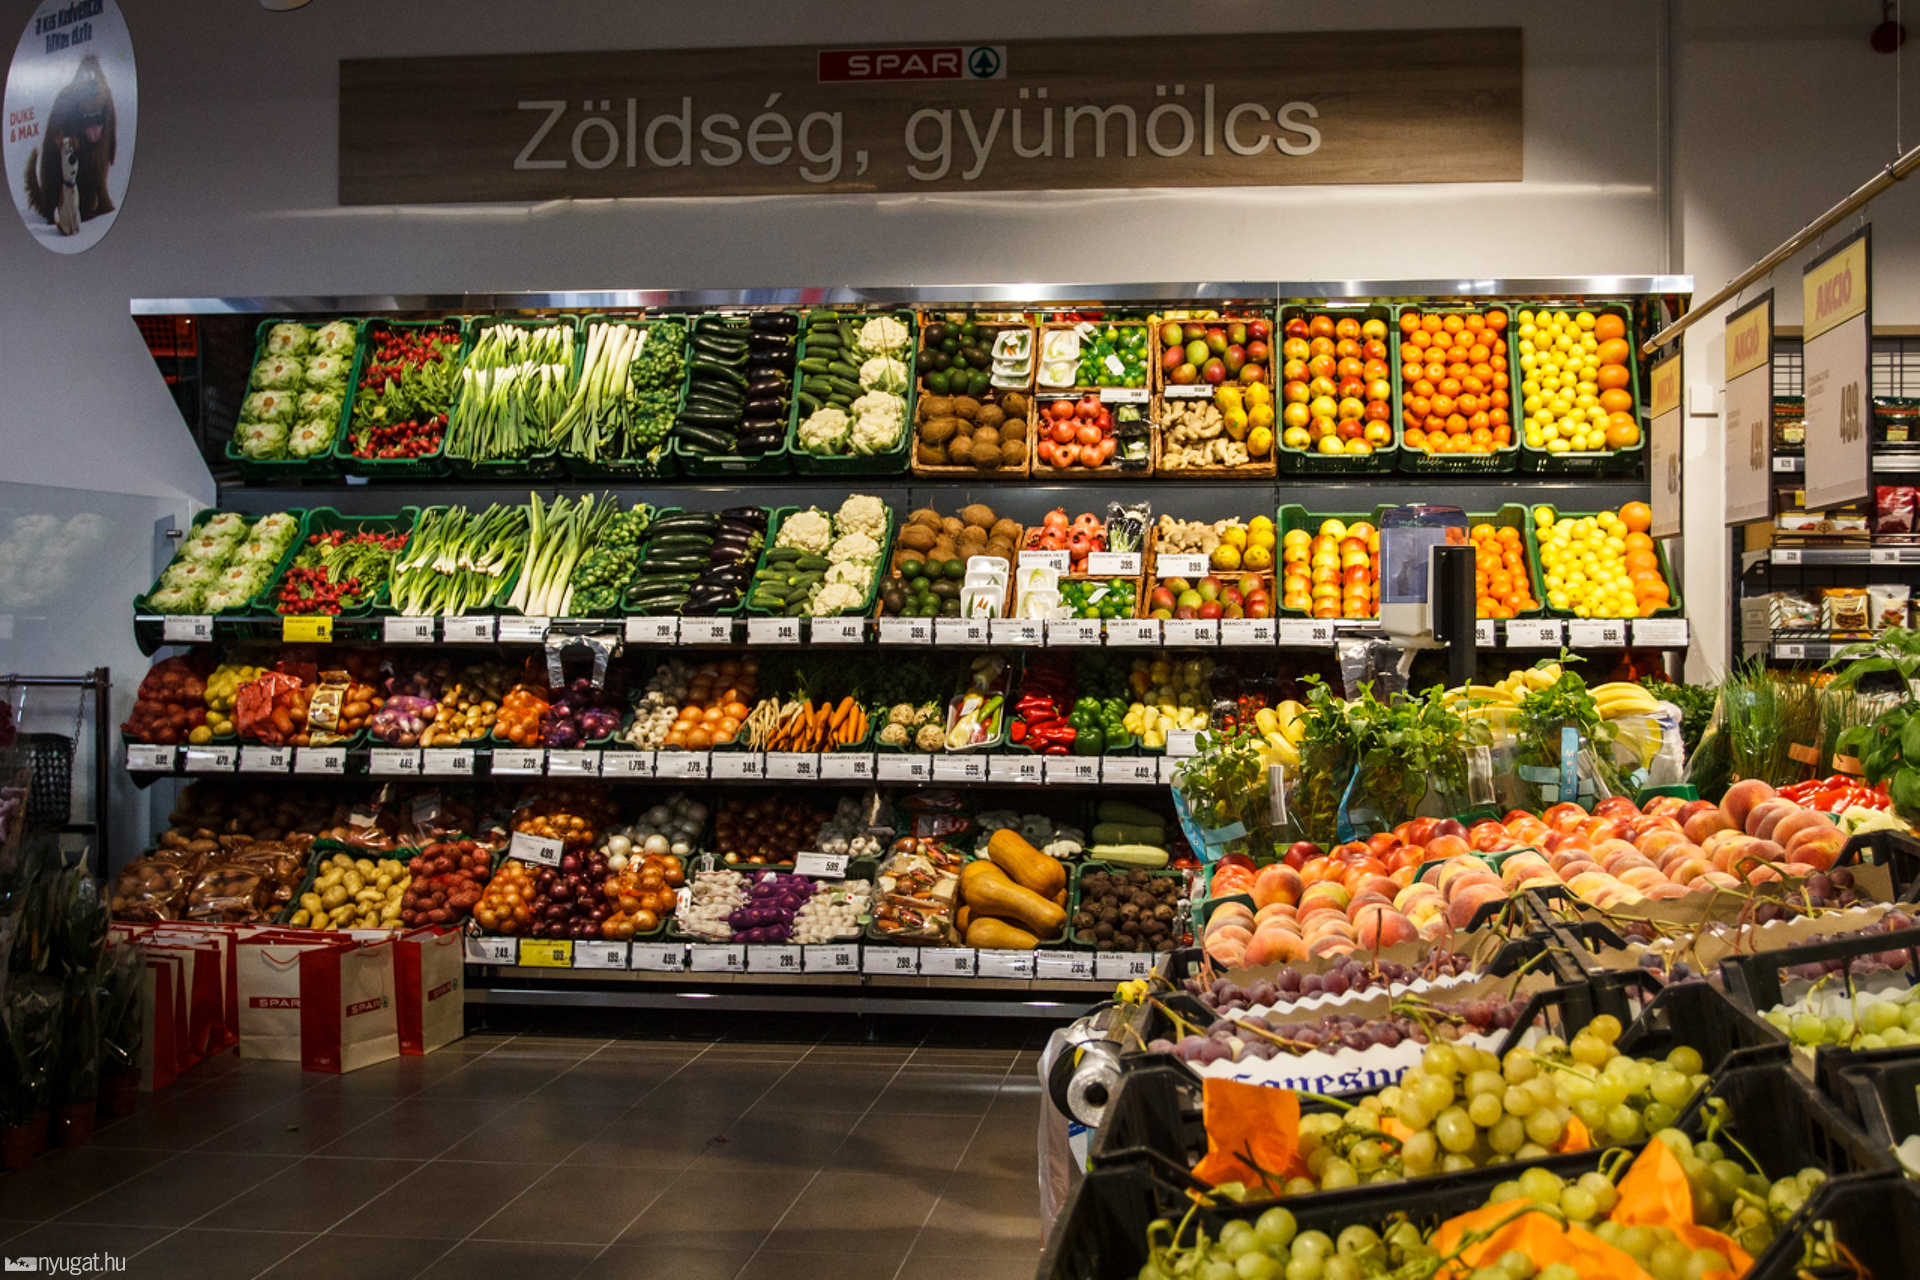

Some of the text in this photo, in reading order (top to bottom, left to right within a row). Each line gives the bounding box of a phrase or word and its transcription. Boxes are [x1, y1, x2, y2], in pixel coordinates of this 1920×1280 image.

[848, 53, 959, 76] SPAR
[9, 106, 36, 127] DUKE
[18, 122, 39, 141] MAX
[513, 84, 1322, 183] Zöldség, gyümölcs
[1815, 257, 1853, 321] AKCIÓ
[258, 999, 301, 1008] SPAR
[351, 1000, 381, 1014] SPAR
